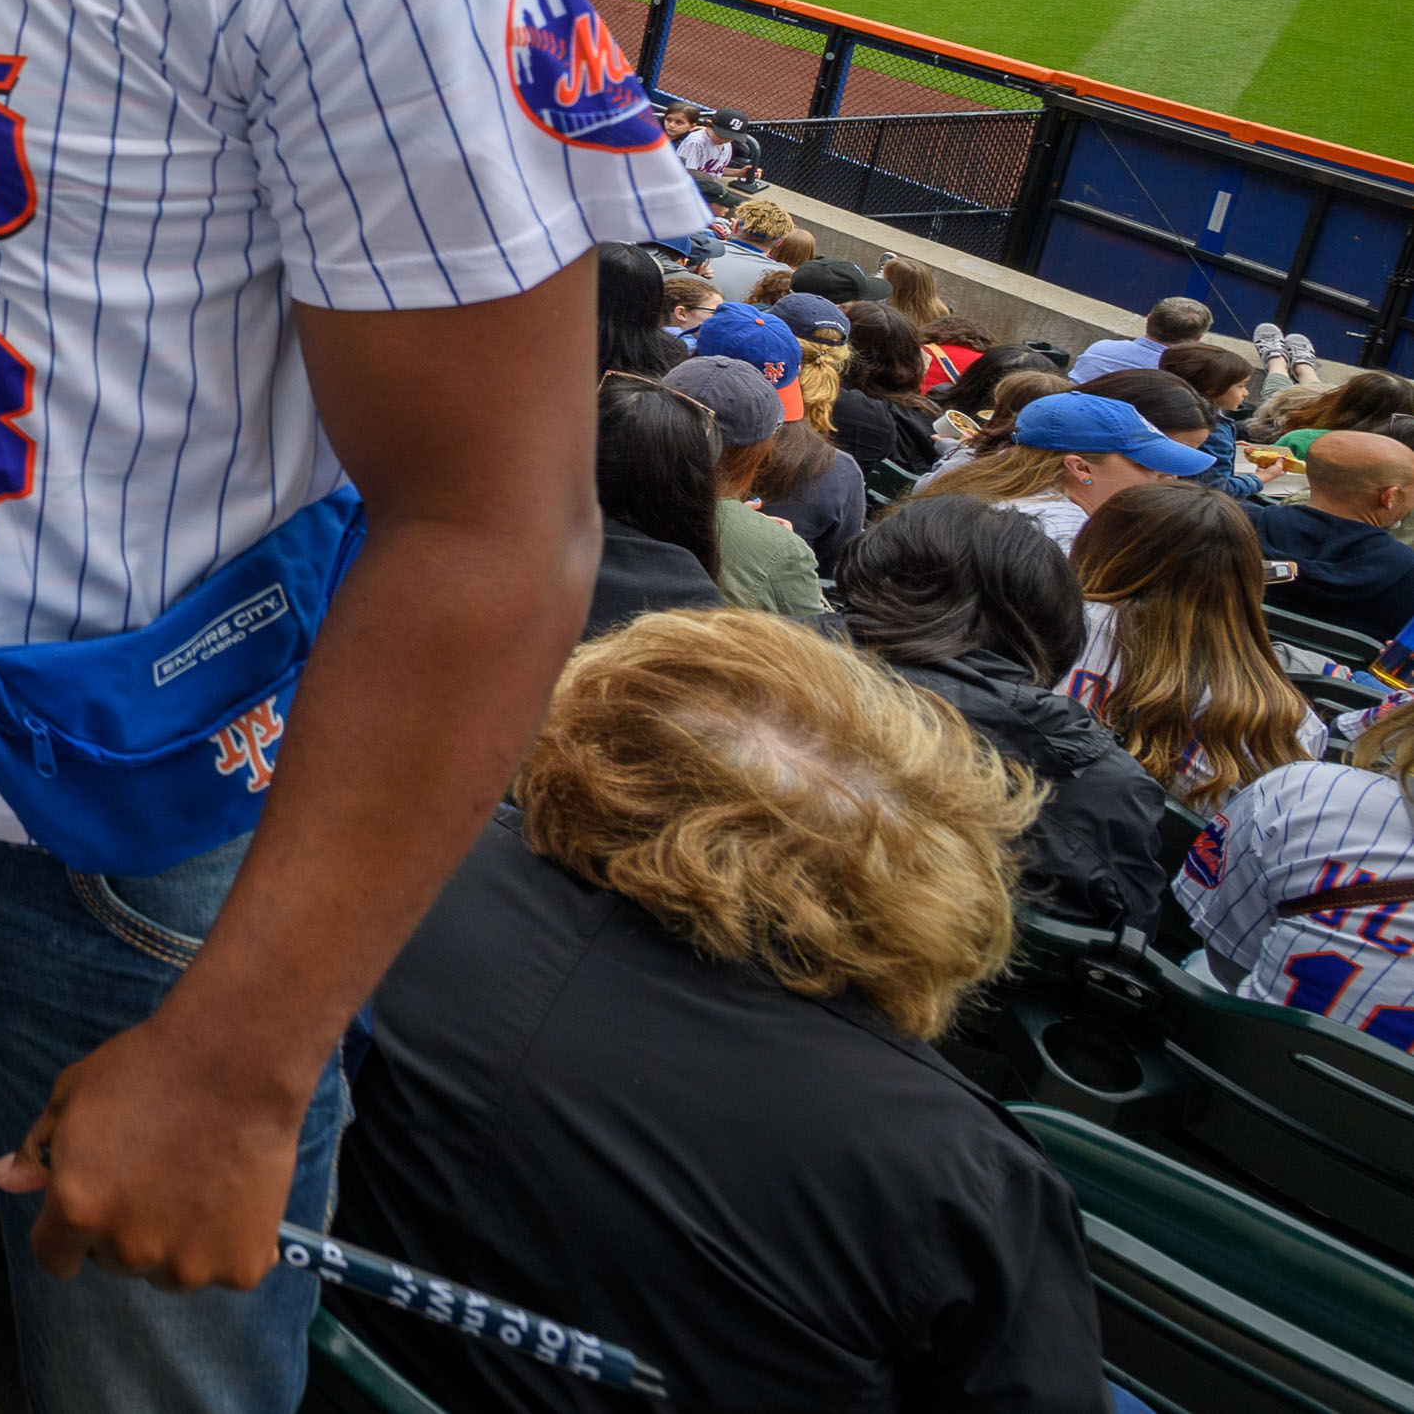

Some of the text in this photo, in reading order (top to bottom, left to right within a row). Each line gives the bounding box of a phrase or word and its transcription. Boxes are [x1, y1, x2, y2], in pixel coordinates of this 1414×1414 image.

[161, 594, 276, 676] EMPIRE CITY
[201, 631, 247, 662] CASINO
